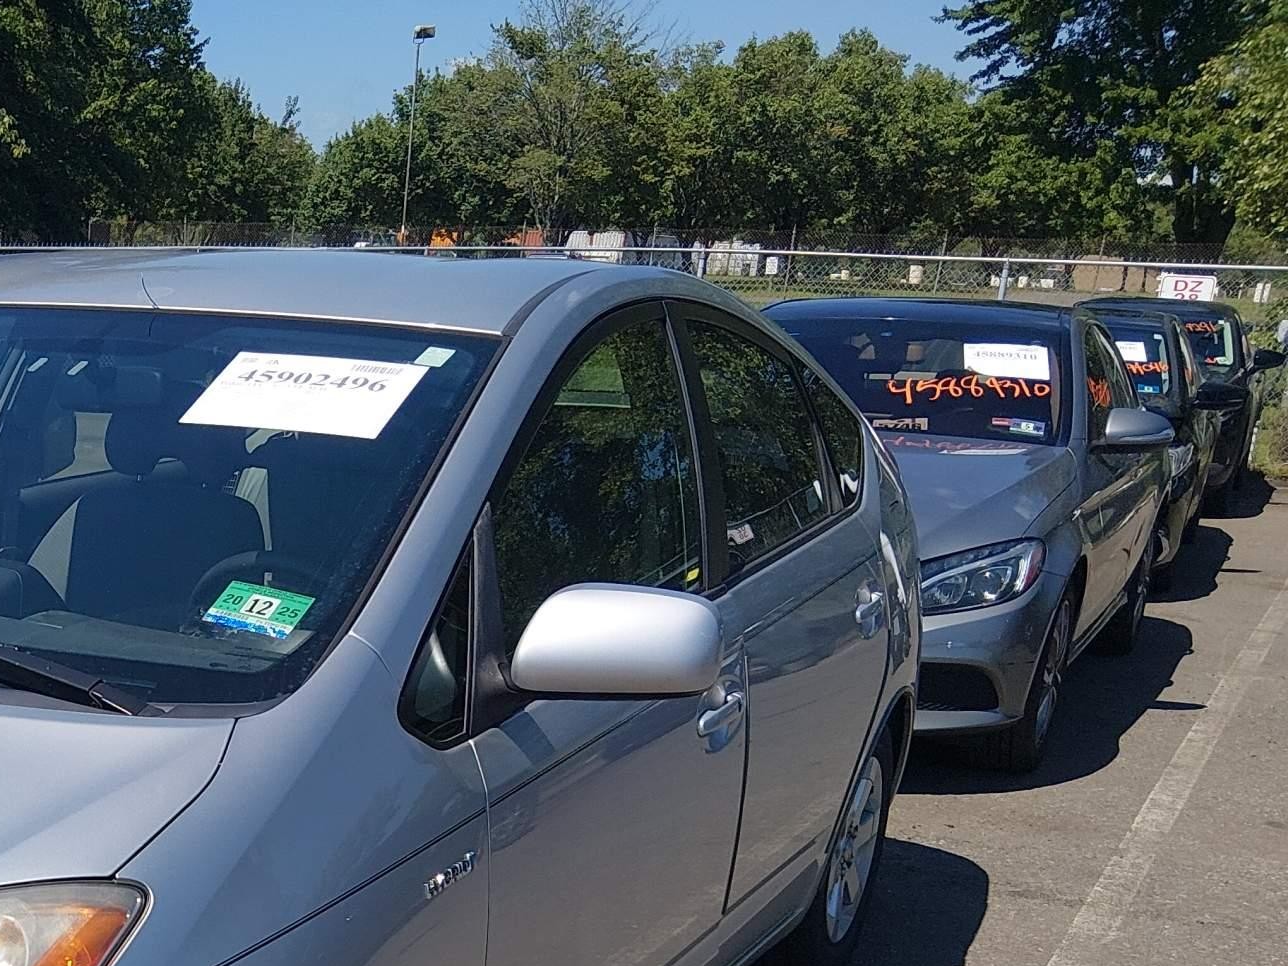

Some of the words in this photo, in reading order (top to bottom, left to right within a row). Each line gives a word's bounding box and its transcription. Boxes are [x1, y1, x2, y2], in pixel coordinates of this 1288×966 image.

[1174, 280, 1203, 293] DZ
[238, 369, 387, 392] 45902496
[223, 594, 244, 606] 20
[245, 598, 273, 616] 12
[278, 606, 301, 618] 25
